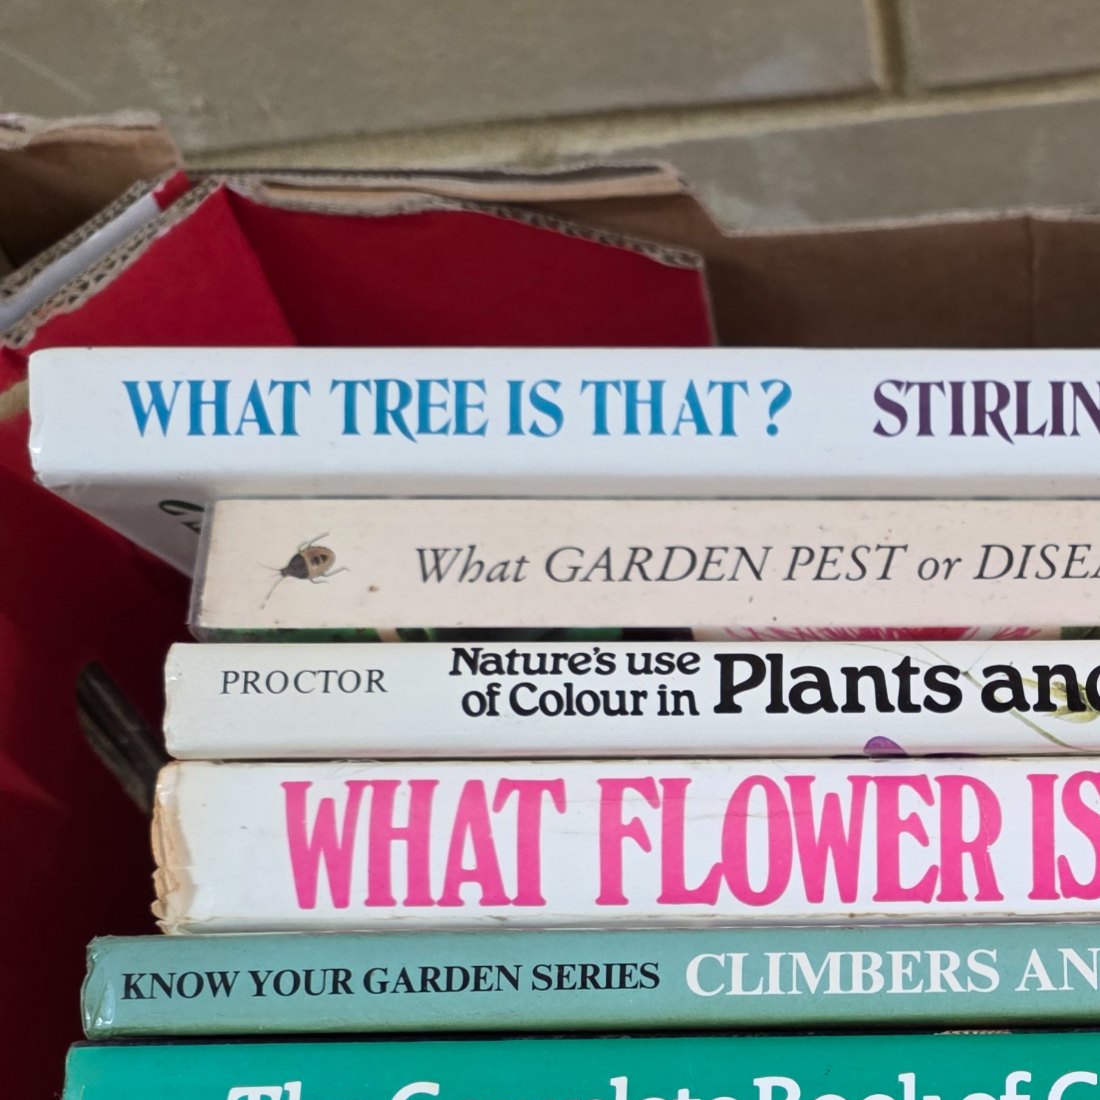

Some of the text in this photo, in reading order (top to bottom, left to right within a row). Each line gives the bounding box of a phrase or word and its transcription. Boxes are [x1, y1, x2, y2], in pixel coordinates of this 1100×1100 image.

[123, 379, 310, 437] WHAT
[330, 378, 489, 443] TREE
[506, 378, 564, 437] IS
[415, 547, 528, 583] What
[545, 546, 770, 583] GARDEN
[783, 545, 907, 582] PEST
[917, 555, 963, 583] or
[450, 646, 701, 678] Nature's use
[220, 669, 388, 696] PROCTOR
[462, 682, 700, 718] of Colour in
[714, 652, 963, 716] Plants
[280, 778, 566, 910] WHAT
[595, 774, 1004, 906] FLOWER
[122, 961, 660, 1001] KNOW YOUR GARDEN SERIES
[686, 949, 999, 997] CLIMBERS
